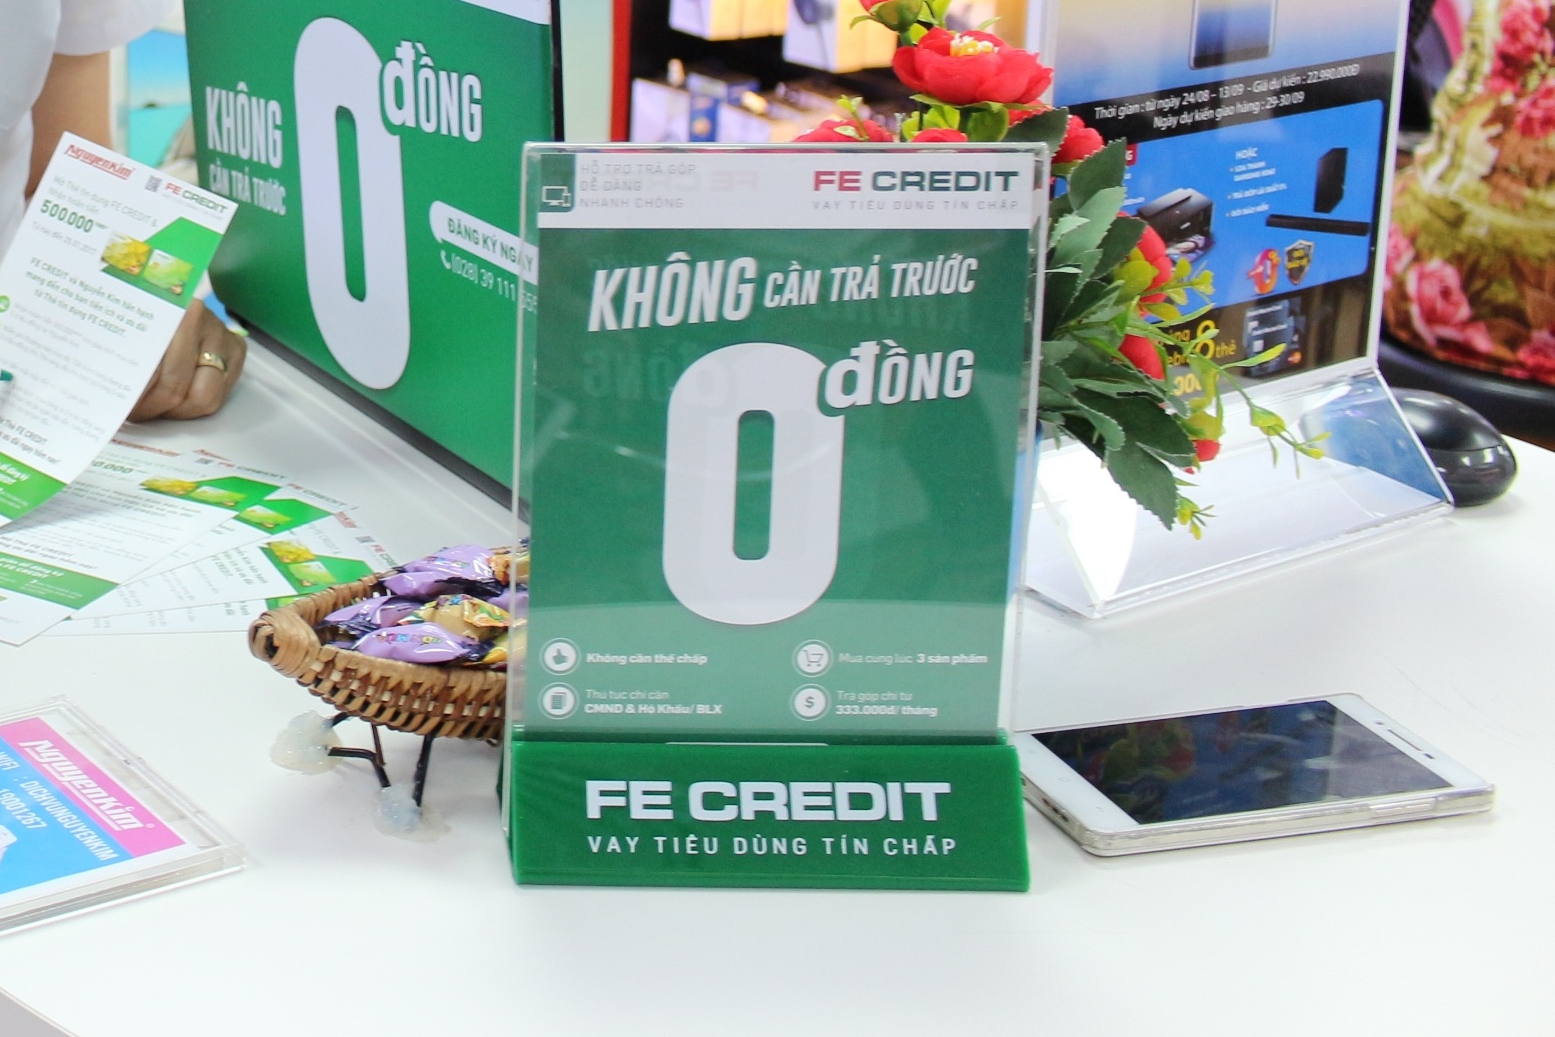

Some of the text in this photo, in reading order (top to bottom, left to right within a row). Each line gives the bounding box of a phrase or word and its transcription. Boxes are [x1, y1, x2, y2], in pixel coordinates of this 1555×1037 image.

[1095, 104, 1118, 121] Thời
[1118, 101, 1141, 119] gian
[1157, 94, 1182, 114] ngày
[205, 81, 283, 169] KHÔNG
[1153, 112, 1179, 131] Ngày
[813, 170, 1020, 193] FE CREDIT
[164, 181, 182, 195] FE
[180, 188, 229, 215] CREDIT
[293, 15, 412, 391] 0
[579, 197, 629, 209] NHANH
[813, 200, 841, 210] VAY
[481, 233, 498, 254] KÝ
[479, 268, 495, 290] 39
[496, 276, 517, 302] 111
[587, 251, 758, 333] KHÔNG
[763, 260, 820, 309] CẦN
[829, 253, 882, 302] TRẢ
[889, 253, 980, 300] TRƯỚC
[1195, 319, 1217, 360] 8
[666, 341, 846, 625] 0
[917, 653, 926, 664] 3
[584, 704, 624, 714] CMND
[625, 704, 636, 714] &
[696, 704, 723, 714] BLX
[585, 779, 952, 822] FE CREDIT
[587, 832, 958, 857] VAY TIÊU DÙNG TÍN CHẤP
